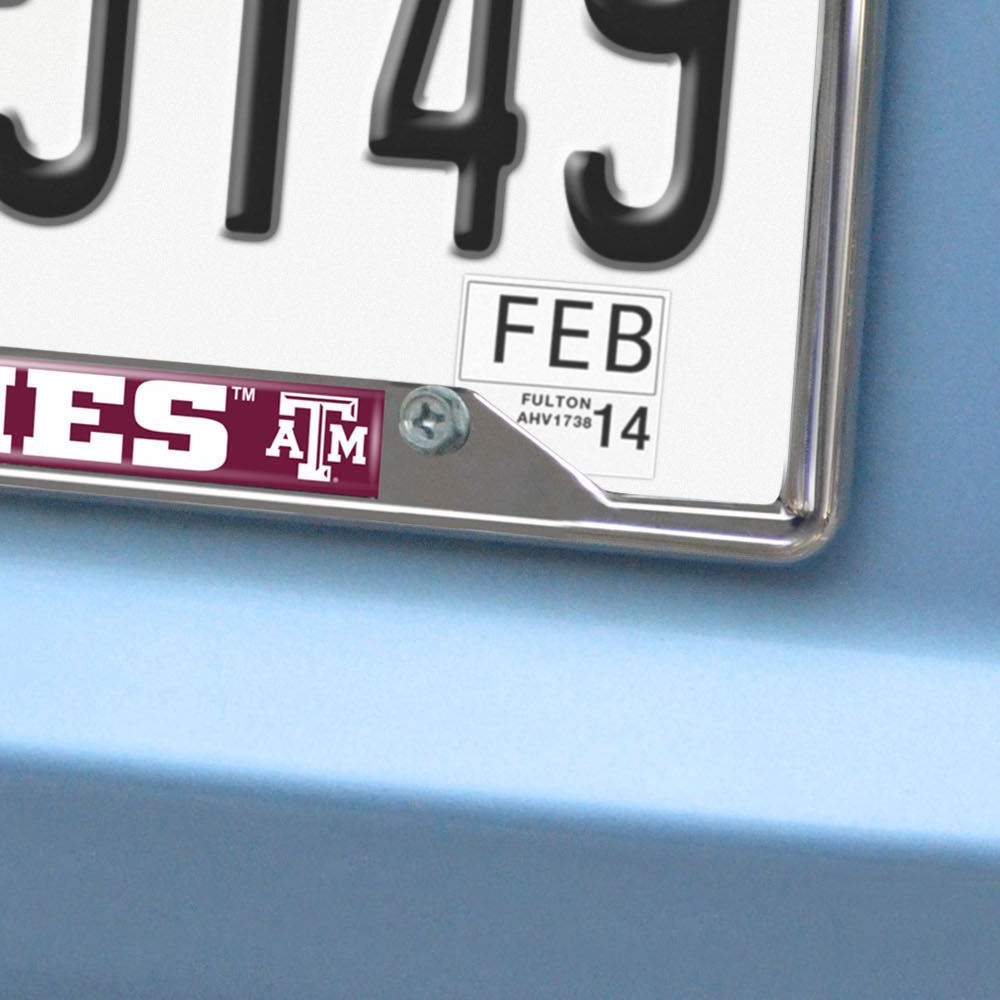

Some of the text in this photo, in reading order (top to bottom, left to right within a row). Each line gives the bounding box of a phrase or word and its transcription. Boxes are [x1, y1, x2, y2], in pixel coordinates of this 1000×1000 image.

[493, 294, 653, 374] FEB
[521, 392, 592, 410] FULTON
[516, 411, 593, 430] AHV1738
[593, 403, 651, 451] 14
